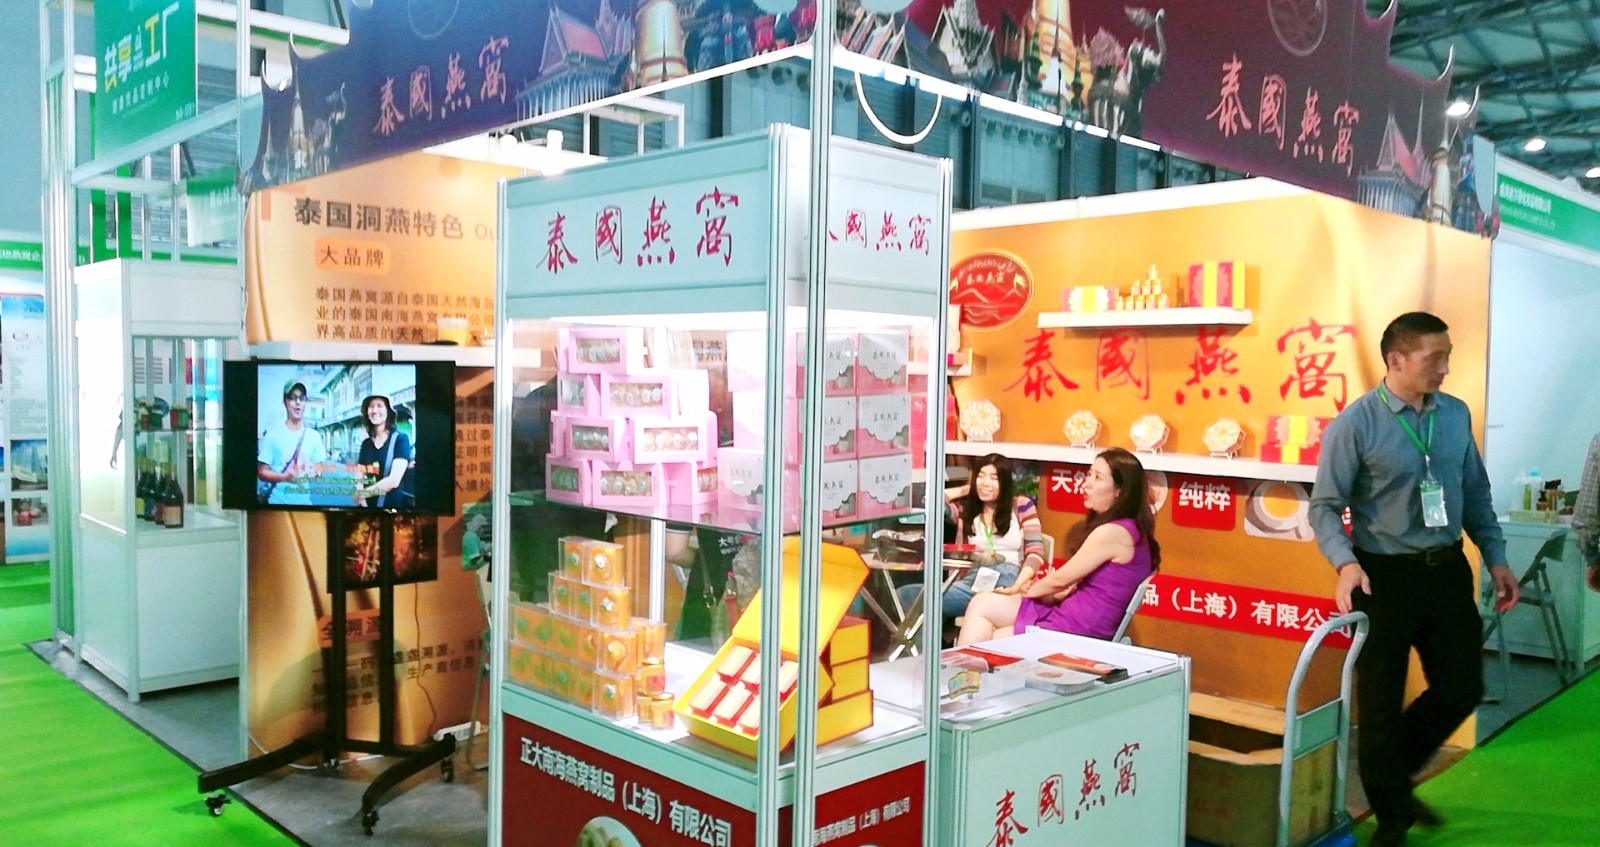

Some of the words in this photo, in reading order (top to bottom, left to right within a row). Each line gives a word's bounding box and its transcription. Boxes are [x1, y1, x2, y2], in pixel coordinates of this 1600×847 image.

[295, 197, 464, 240] 泰国洞燕特色
[320, 245, 385, 269] 大品牌
[1178, 480, 1232, 511] 纯粹
